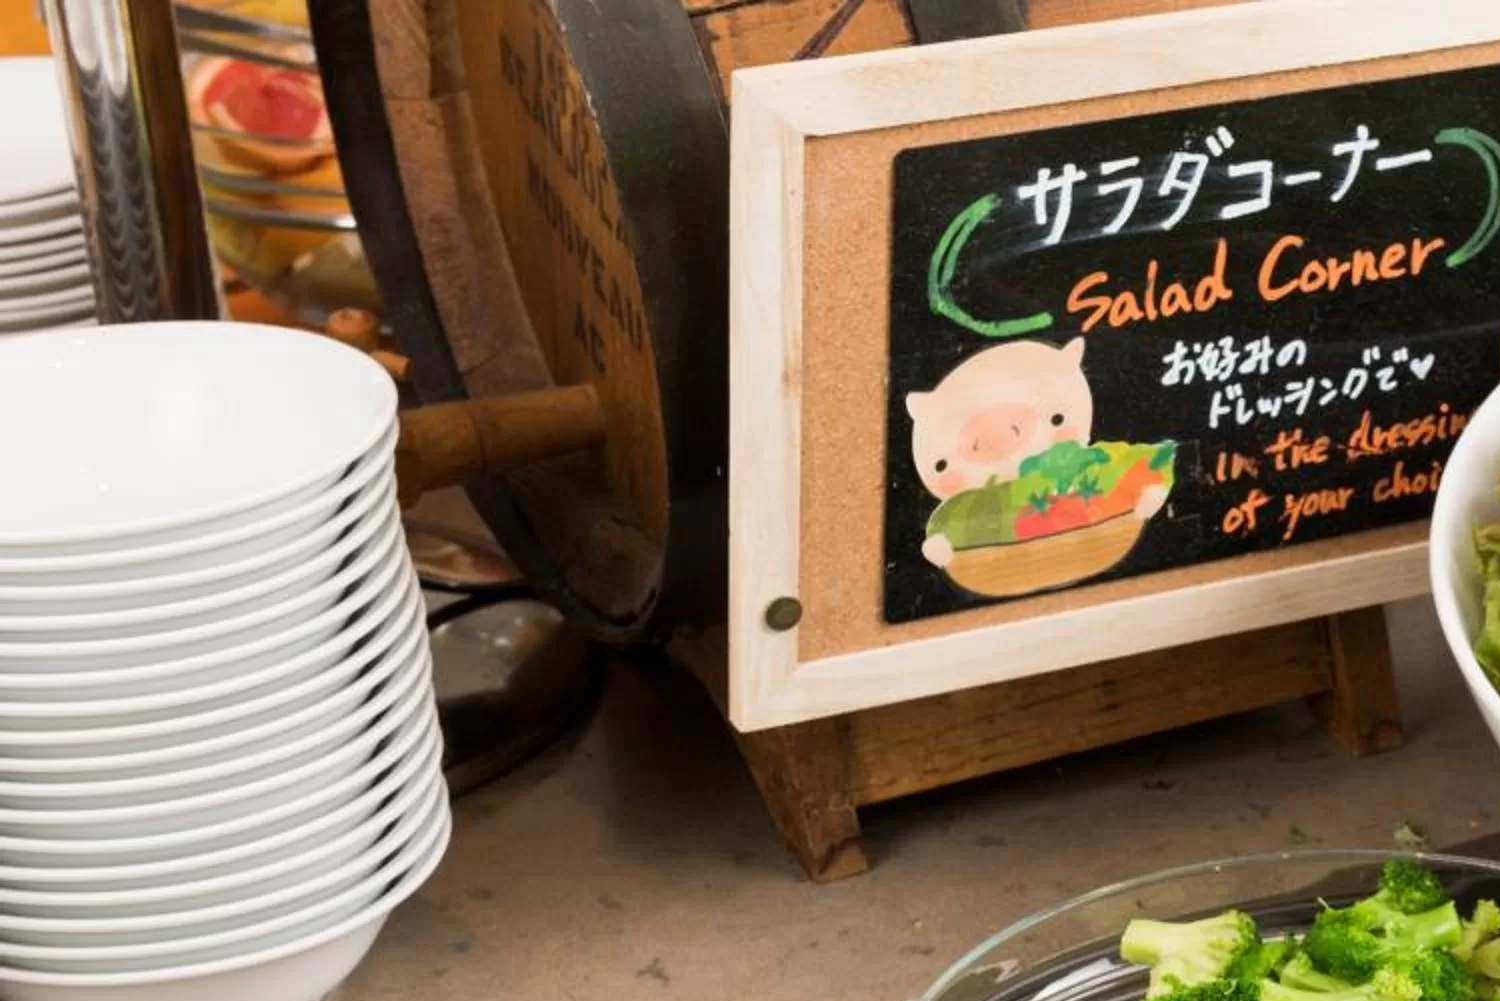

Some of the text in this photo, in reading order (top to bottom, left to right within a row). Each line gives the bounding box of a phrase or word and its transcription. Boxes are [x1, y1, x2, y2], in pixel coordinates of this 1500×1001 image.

[1017, 124, 1433, 246] サラダコーナー
[1066, 234, 1445, 333] Salad Corner
[1160, 335, 1308, 386] お好みの
[1264, 427, 1331, 471] the
[1348, 404, 1466, 458] dressin
[1221, 461, 1441, 542] of your choi
